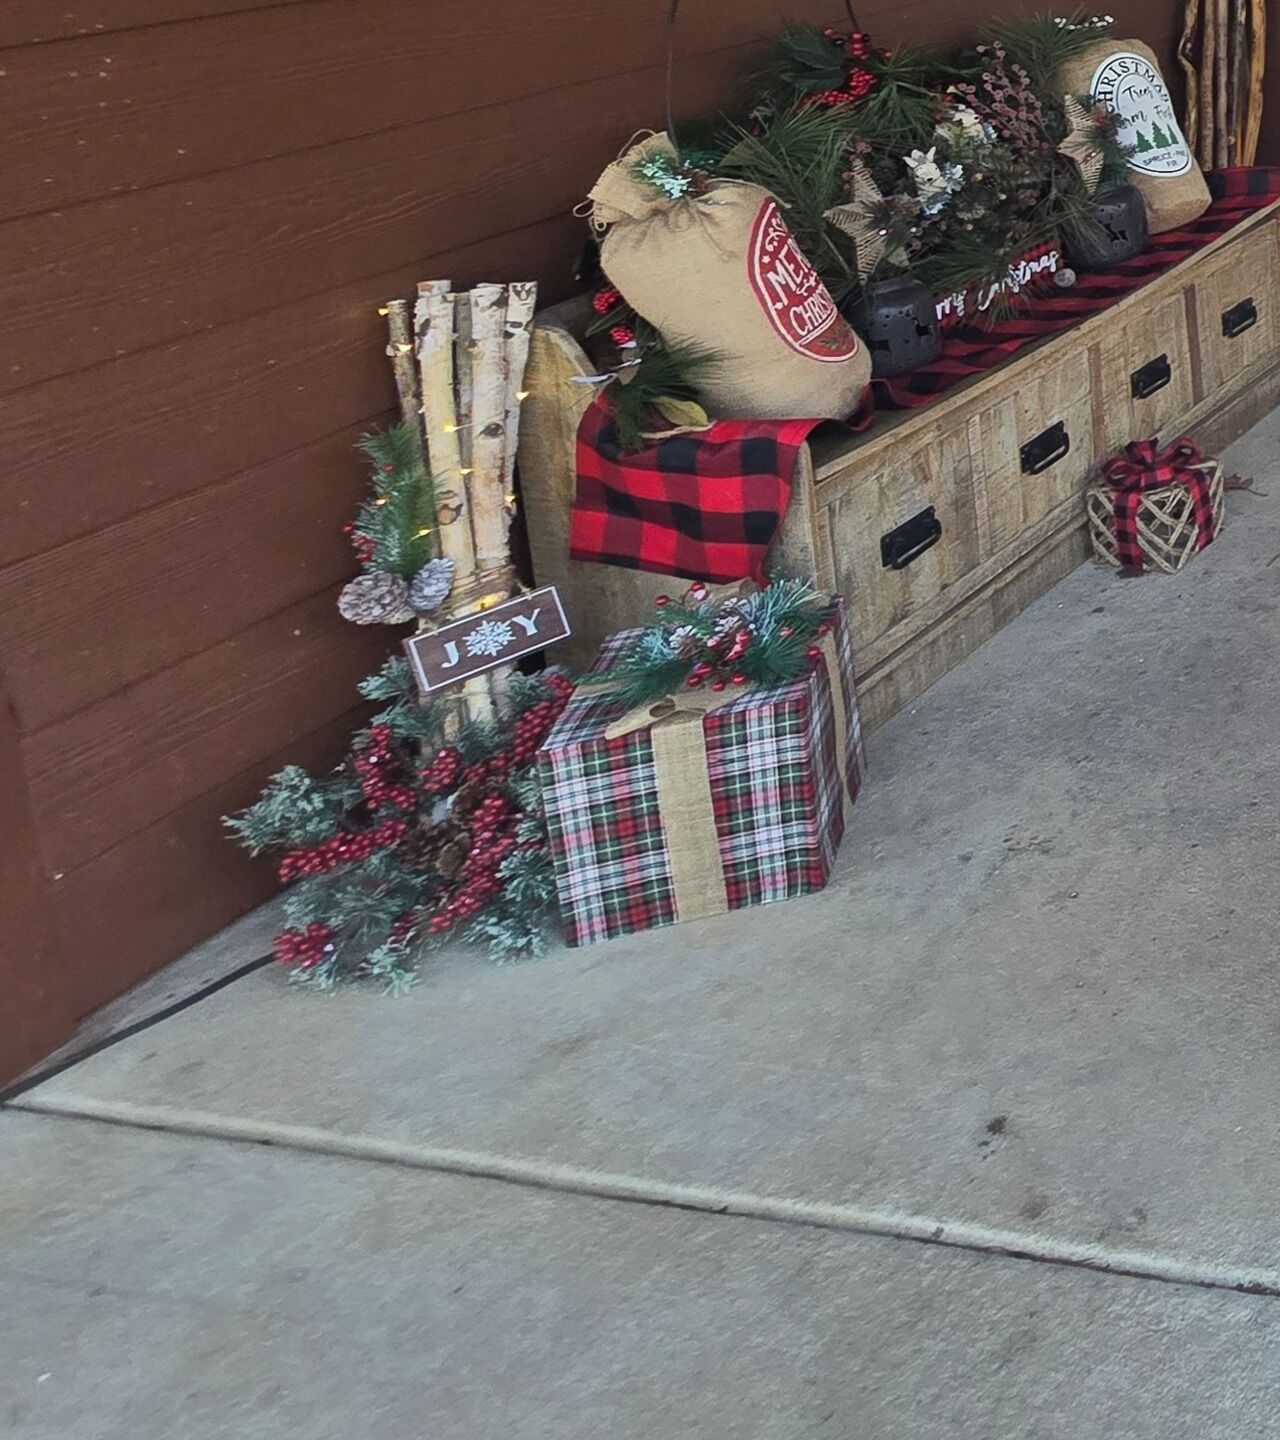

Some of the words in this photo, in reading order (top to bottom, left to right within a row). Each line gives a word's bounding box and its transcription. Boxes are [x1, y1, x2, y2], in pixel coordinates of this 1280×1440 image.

[1142, 151, 1171, 166] SPRUCE
[1166, 160, 1179, 168] FIR
[935, 289, 968, 321] rry
